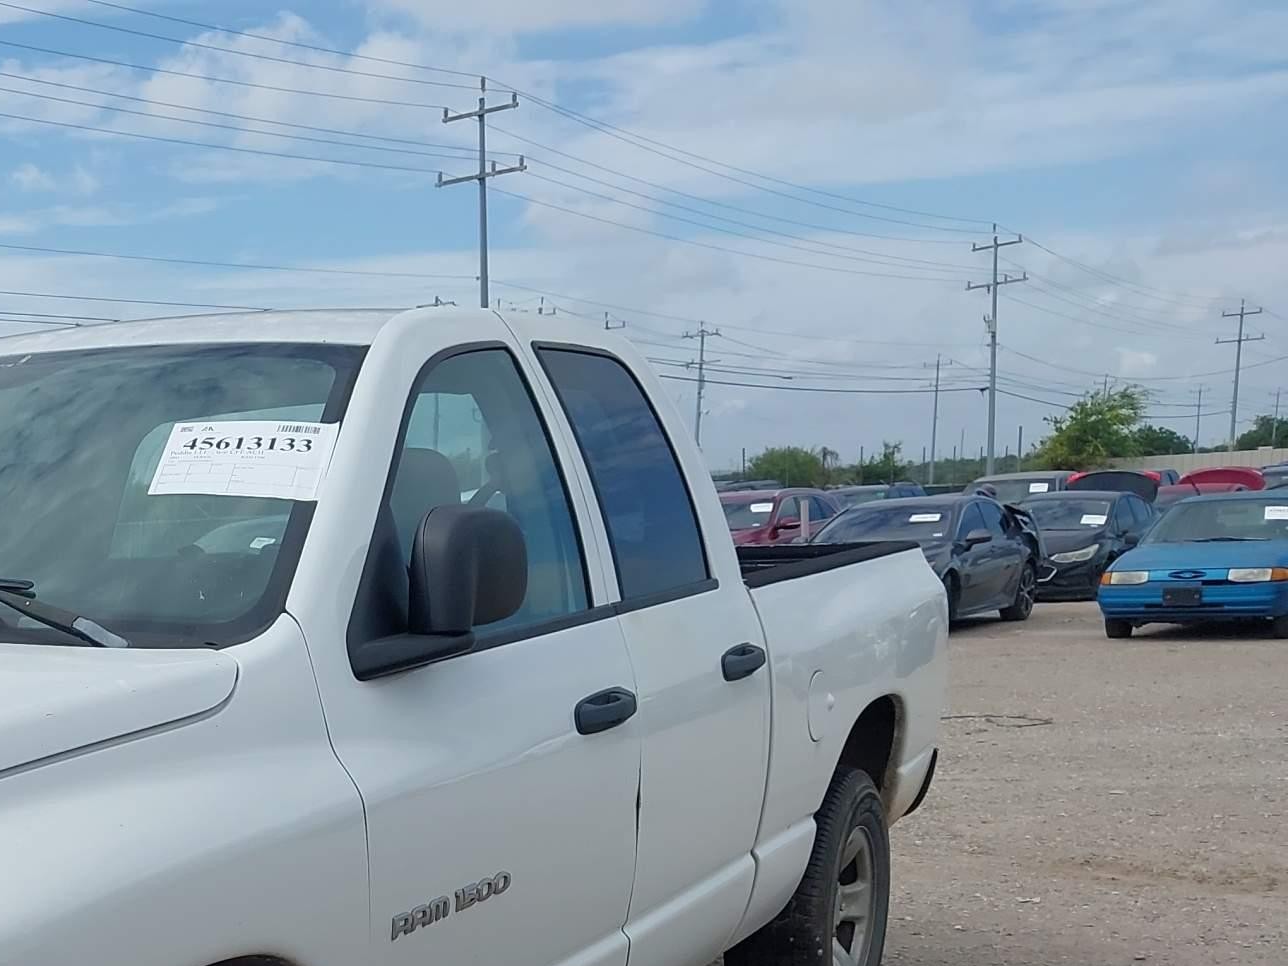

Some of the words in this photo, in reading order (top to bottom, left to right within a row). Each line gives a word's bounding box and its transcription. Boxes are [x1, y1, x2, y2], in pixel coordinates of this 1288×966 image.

[183, 436, 314, 453] 45613133
[391, 895, 451, 942] RAM
[455, 870, 512, 913] 1500
